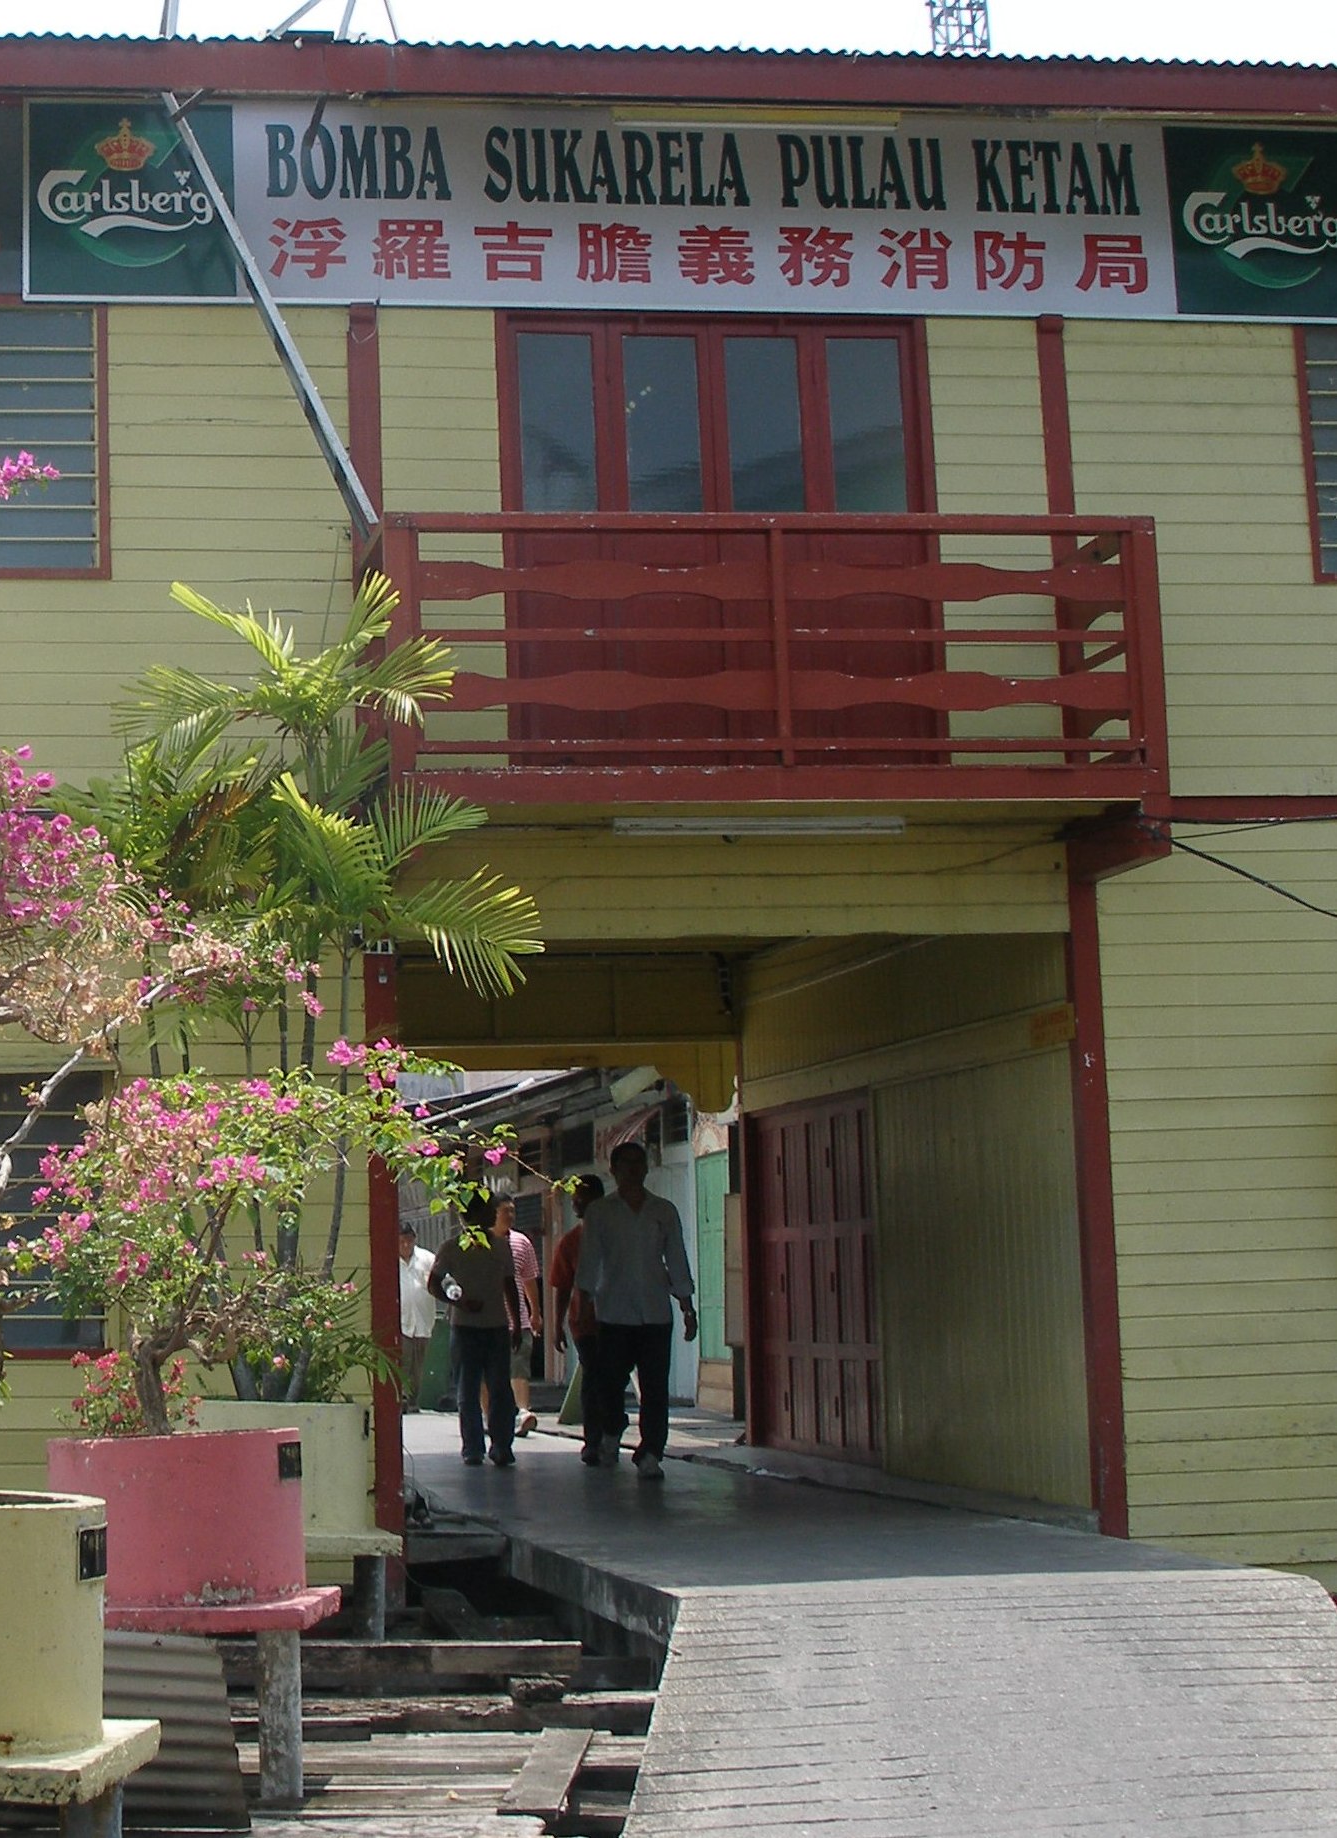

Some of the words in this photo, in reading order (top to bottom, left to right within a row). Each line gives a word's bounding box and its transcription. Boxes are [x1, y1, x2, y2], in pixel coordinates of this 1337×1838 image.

[37, 170, 214, 238] Carlsberg
[265, 123, 453, 201] BOMBA
[484, 125, 751, 208] SUKARELA
[777, 133, 948, 212] PULAU
[971, 138, 1141, 217] KETAM
[268, 216, 1149, 295] 浮羅吉膽義務消防局
